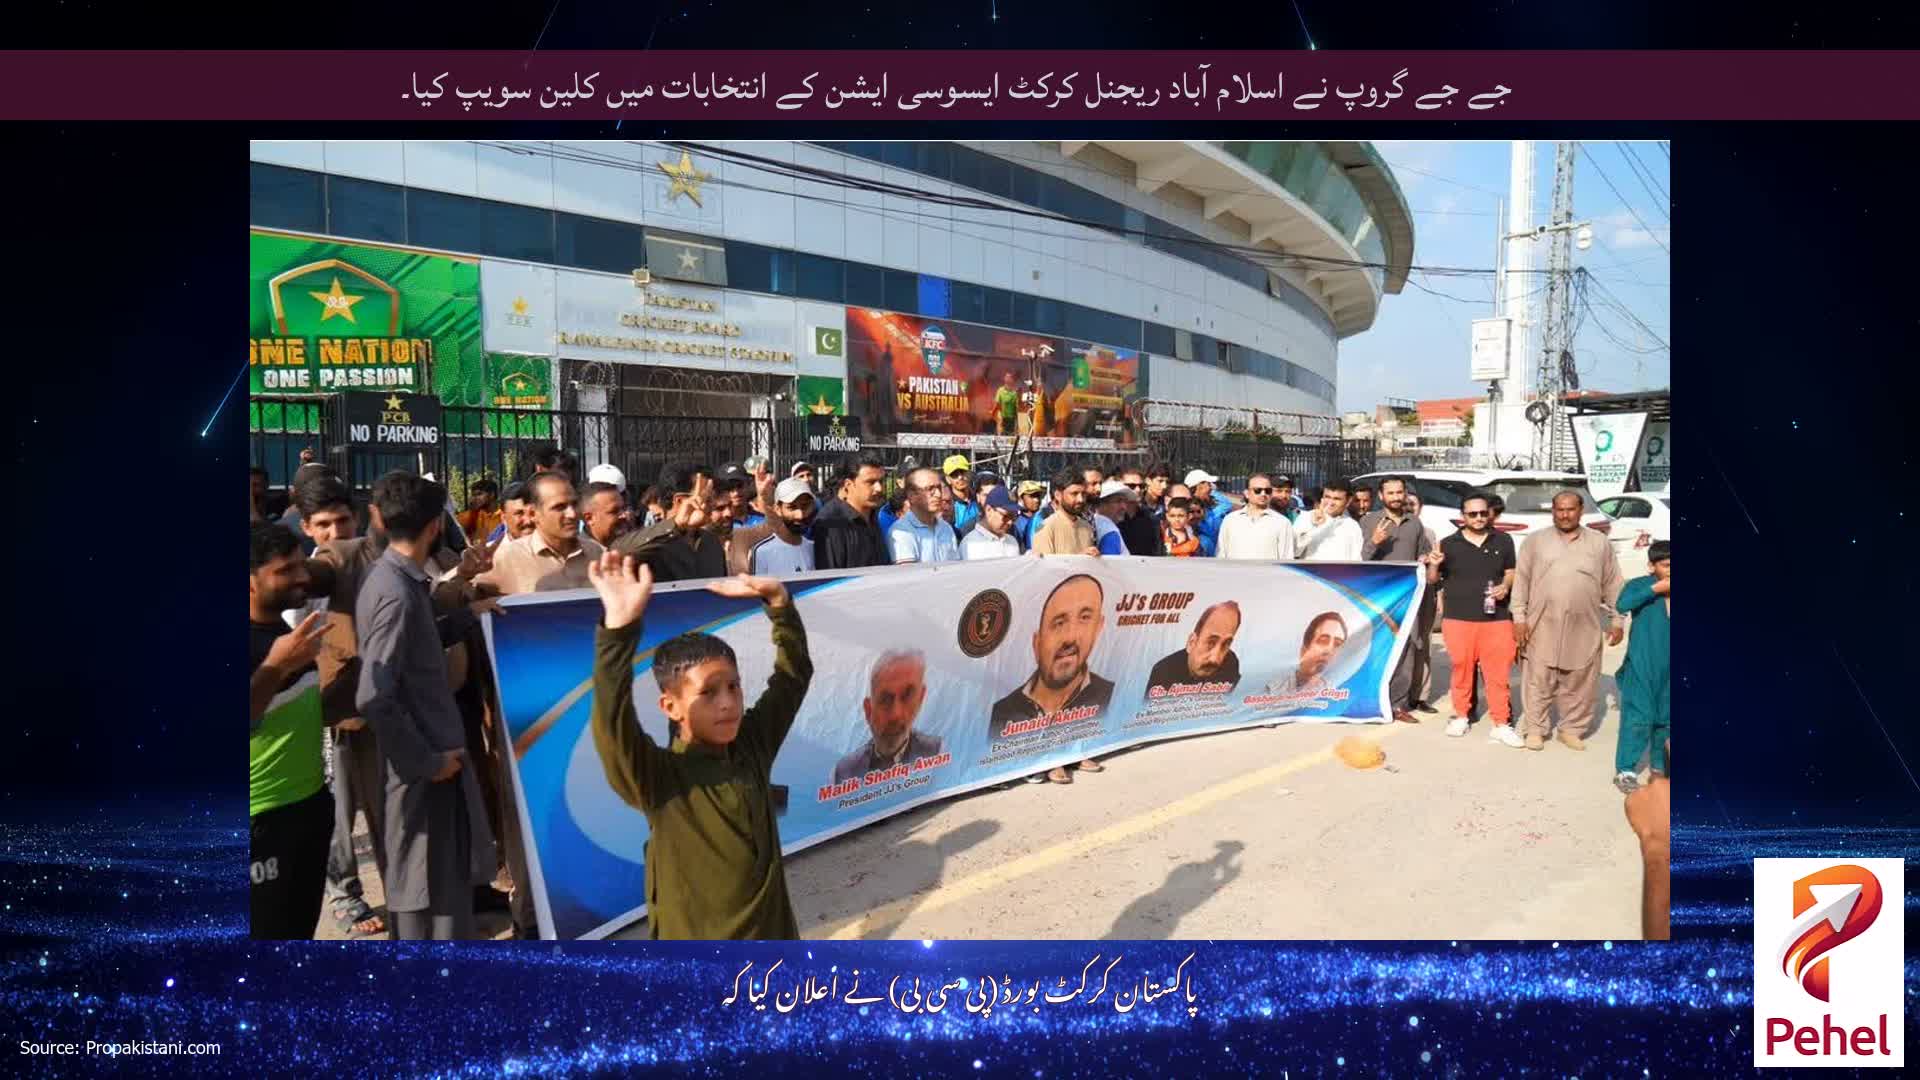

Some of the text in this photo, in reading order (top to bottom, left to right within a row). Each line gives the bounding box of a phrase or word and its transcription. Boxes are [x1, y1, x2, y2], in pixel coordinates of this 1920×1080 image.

[924, 340, 946, 350] KFC
[263, 367, 413, 388] ONE PASSION
[908, 376, 959, 396] PAKISTAN
[896, 392, 970, 412] VS AUSTRALIA
[381, 411, 412, 424] PCB
[350, 423, 438, 444] NO PARKING
[809, 435, 860, 452] NO PARKING
[1115, 591, 1195, 612] JJ's GROUP
[1116, 612, 1181, 627] CRICKET FOR ALL
[1168, 682, 1201, 697] Ajmal
[1319, 687, 1350, 699] Gilgit
[1001, 704, 1100, 737] Junaid Akhtar
[817, 752, 952, 802] Malik Shafiq Awan
[838, 787, 883, 809] President
[903, 774, 931, 790] Group
